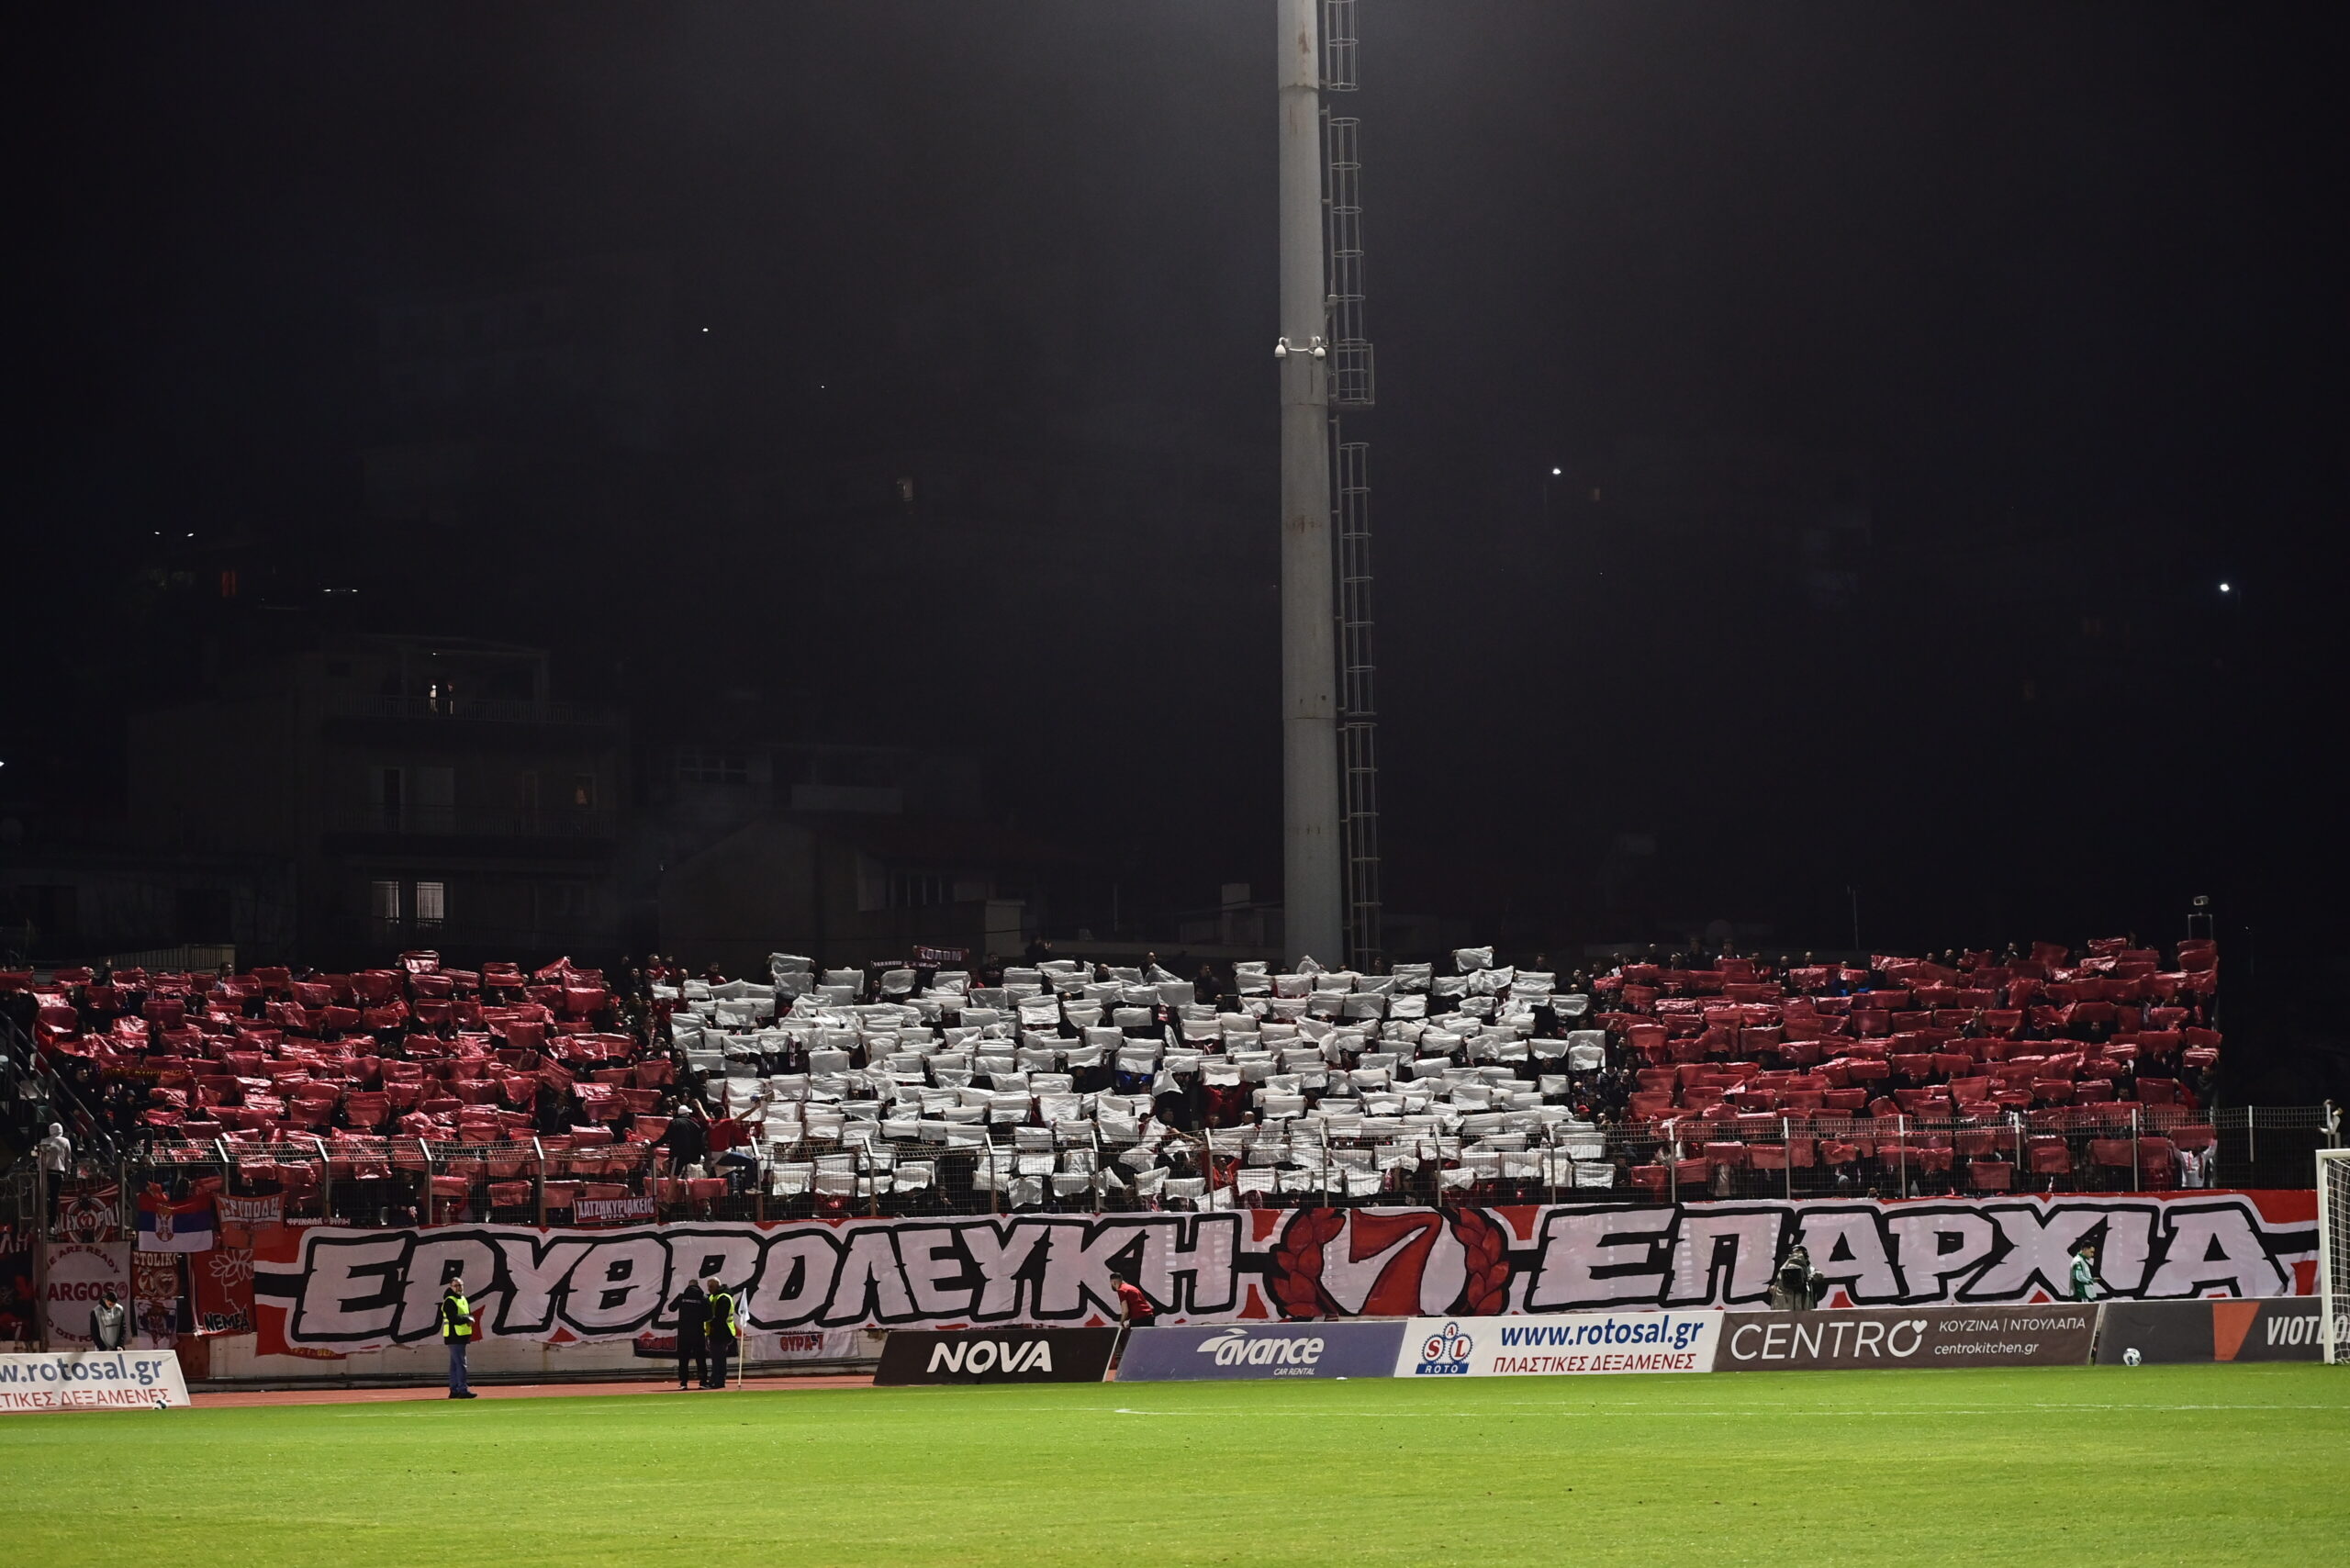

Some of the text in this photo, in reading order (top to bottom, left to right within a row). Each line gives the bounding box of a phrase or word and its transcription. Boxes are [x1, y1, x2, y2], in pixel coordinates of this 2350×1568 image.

[59, 1245, 82, 1258] ARE
[85, 1246, 120, 1273] READY
[291, 1213, 1242, 1342] ΕΡΥΘΡΟΛΕΥΚΗ
[1524, 1202, 2289, 1313] ΕΠΑΡΧΙΑ
[47, 1282, 115, 1301] ARGOS
[55, 1327, 75, 1342] DIE
[79, 1334, 93, 1342] FO
[1501, 1315, 1704, 1350] www.rotosal.gr
[1939, 1317, 2087, 1333] ΚΟΥΖΙΝΑ ΝΤΟΥΛΑΠΑ
[2266, 1315, 2350, 1346] VIOTO
[1731, 1319, 1925, 1361] CENTRO
[1934, 1340, 2040, 1356] centrokitchen.gr
[926, 1339, 1053, 1372] NOVA
[1214, 1338, 1325, 1366] avance
[1289, 1367, 1315, 1375] RENTAL
[1425, 1364, 1459, 1373] ROTO
[1494, 1353, 1697, 1373] ΠΛΑΣΤΙΚΕΣ ΔΕΞΑΜΕΝΕΣ
[0, 1388, 173, 1408] ΤΙΚΕΣ ΔΕΞΑΜΕΝΕΣ
